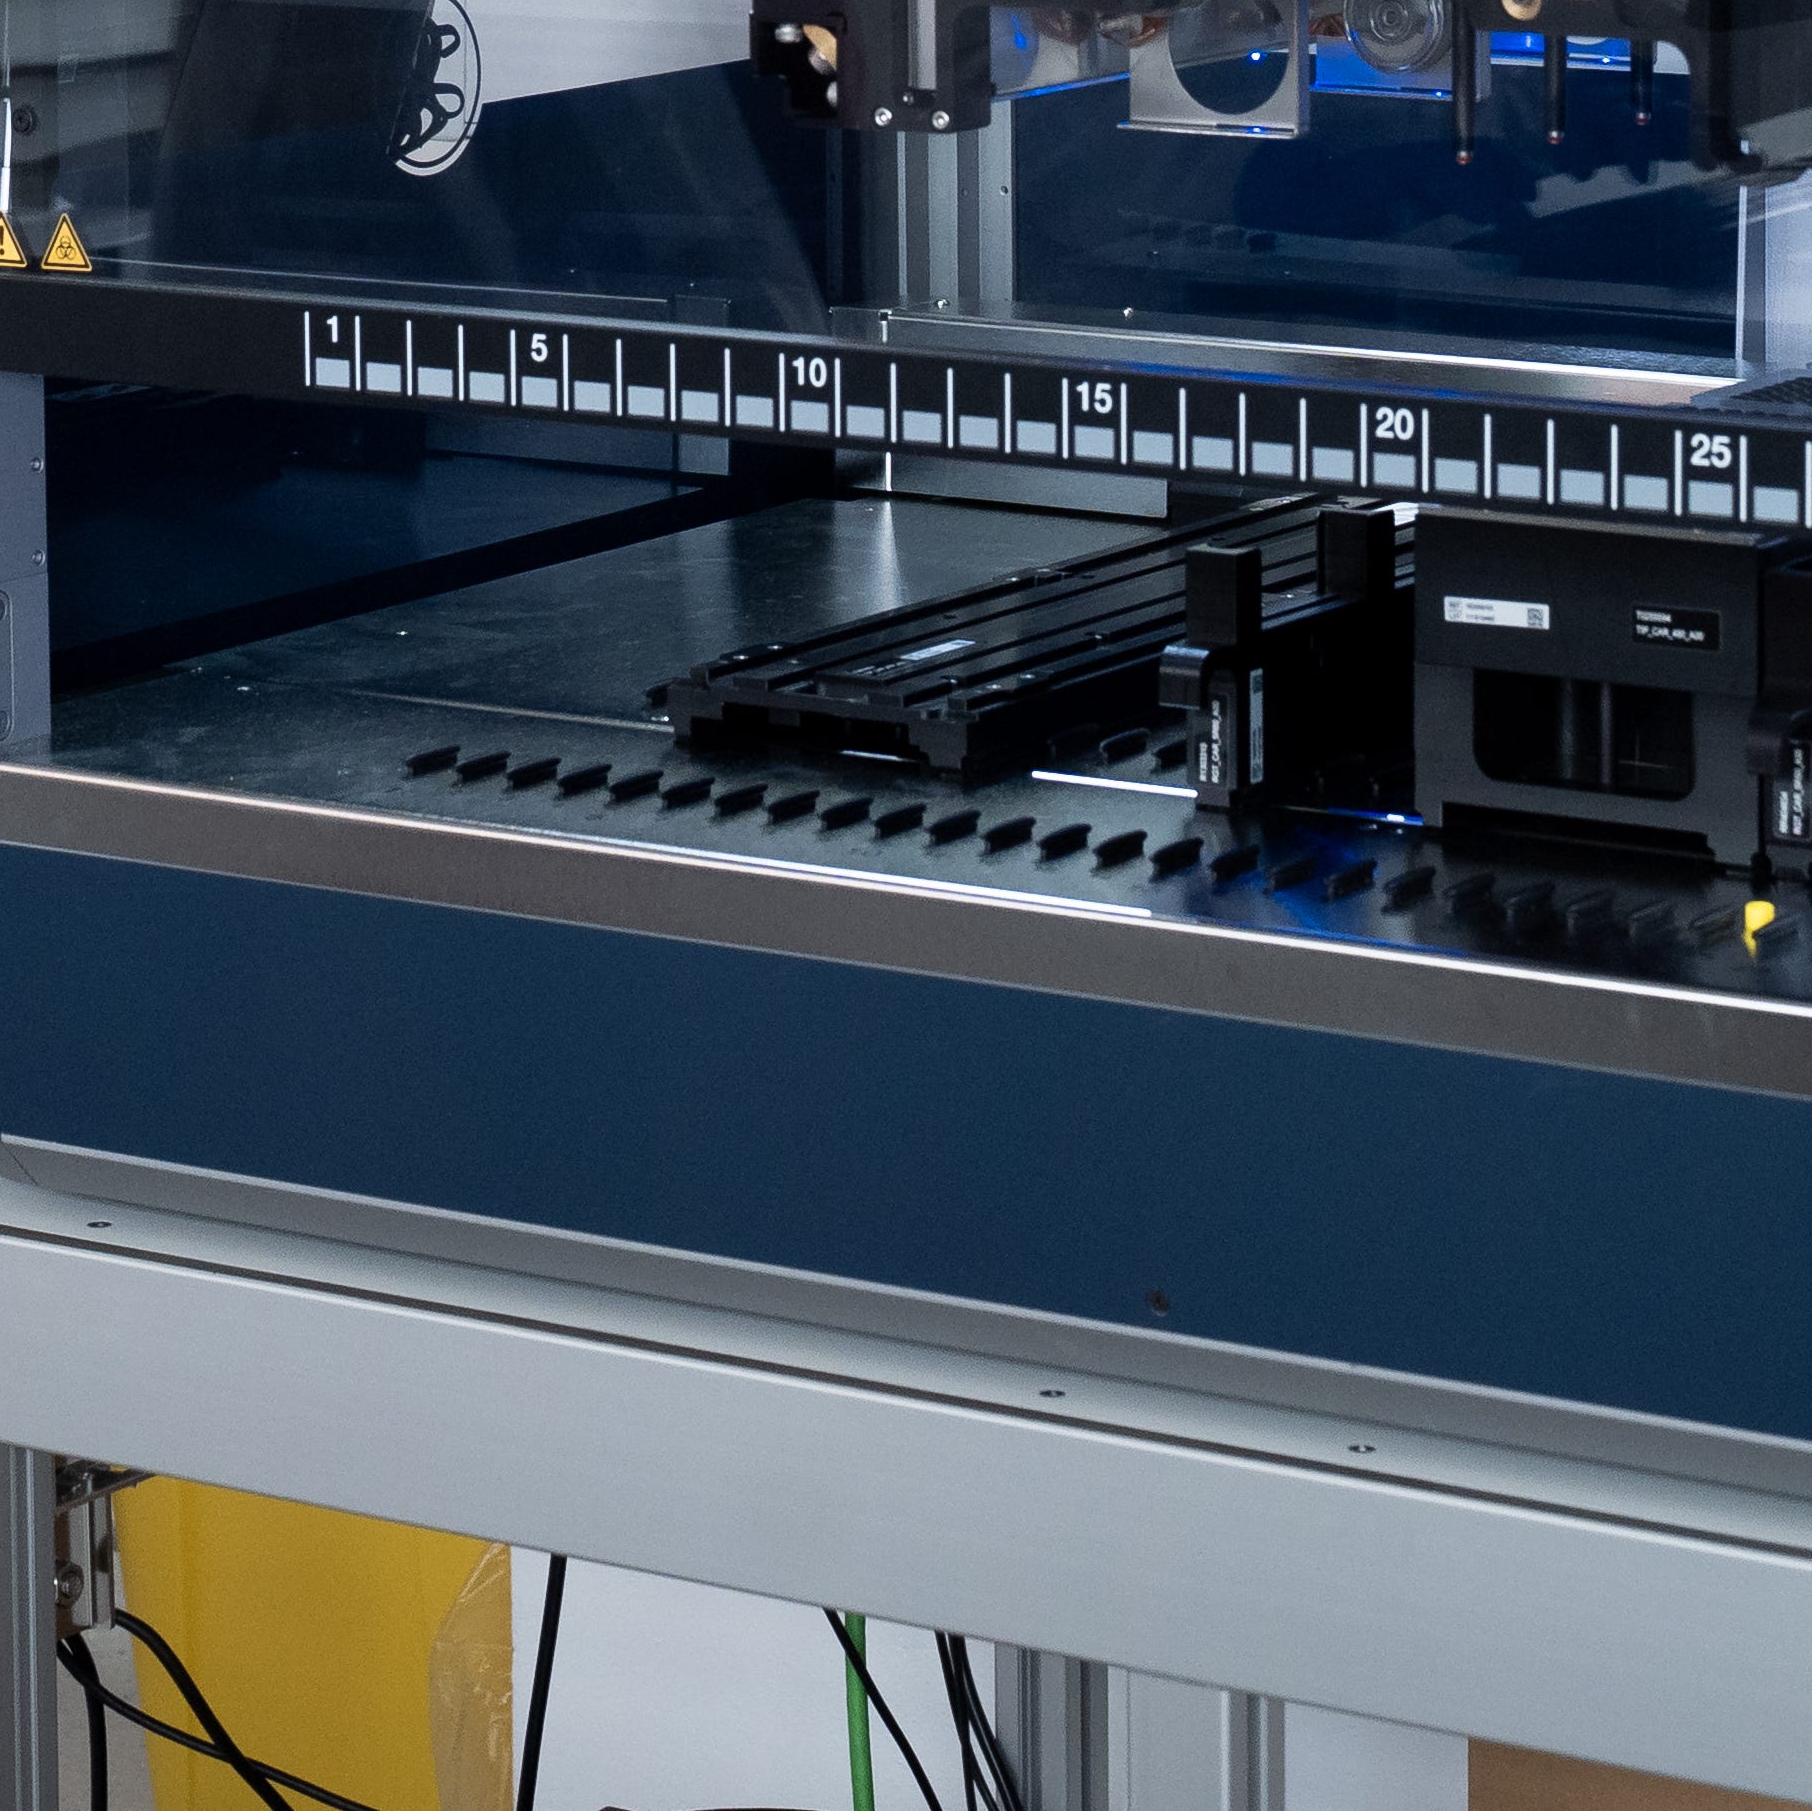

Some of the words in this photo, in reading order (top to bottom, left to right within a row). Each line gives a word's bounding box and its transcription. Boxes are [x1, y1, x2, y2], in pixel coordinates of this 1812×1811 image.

[325, 315, 339, 343] 1
[529, 333, 549, 362] 5
[791, 356, 827, 388] 10
[1075, 382, 1113, 414] 15
[1374, 406, 1415, 440] 20
[1689, 433, 1732, 468] 25
